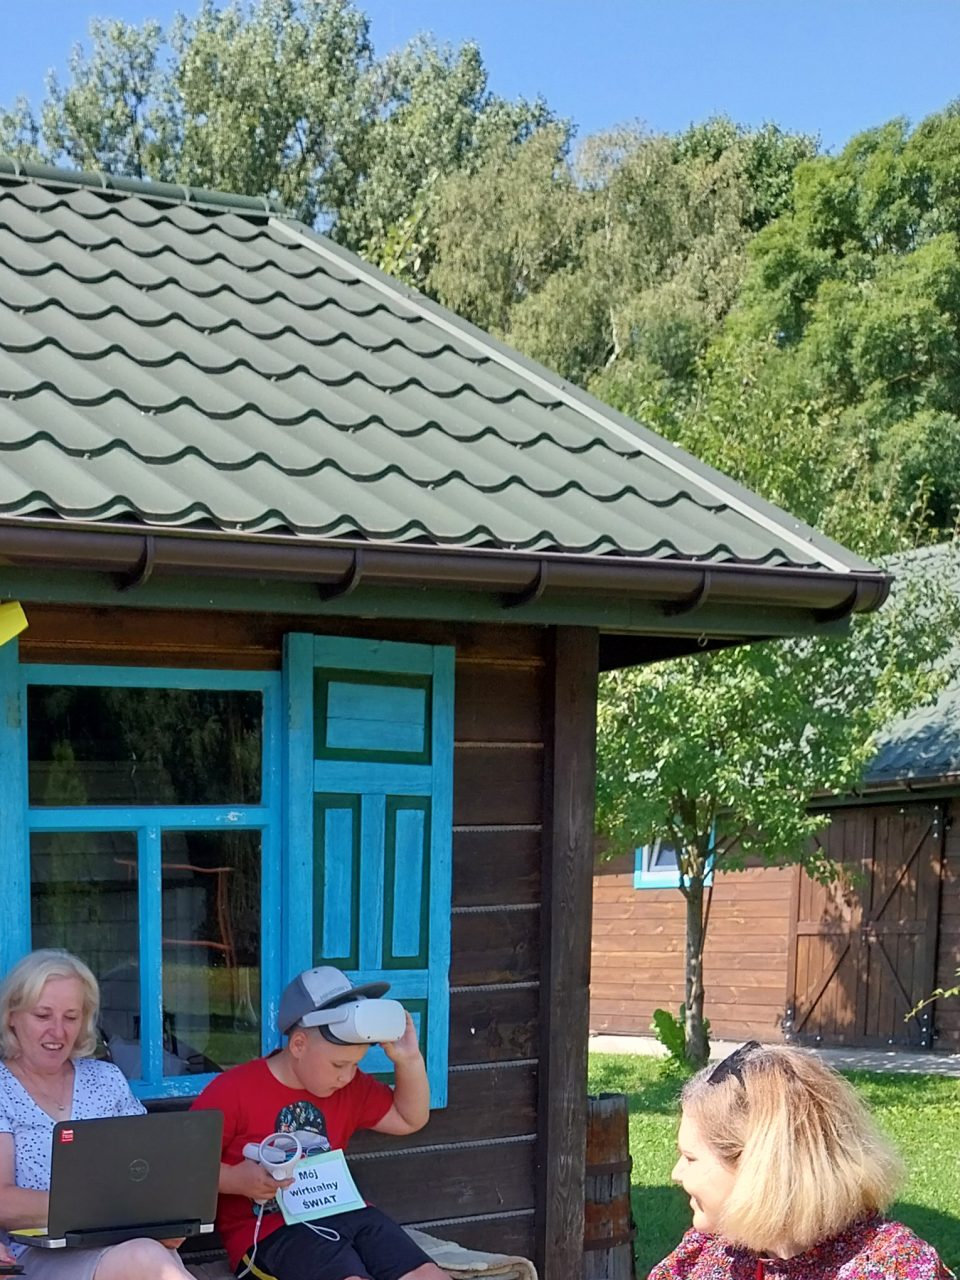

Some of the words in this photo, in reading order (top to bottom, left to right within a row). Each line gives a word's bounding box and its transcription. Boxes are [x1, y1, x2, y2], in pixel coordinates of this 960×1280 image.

[298, 1169, 319, 1180] Mój
[290, 1182, 338, 1196] wirtualny
[302, 1194, 337, 1209] ŚWIAT
